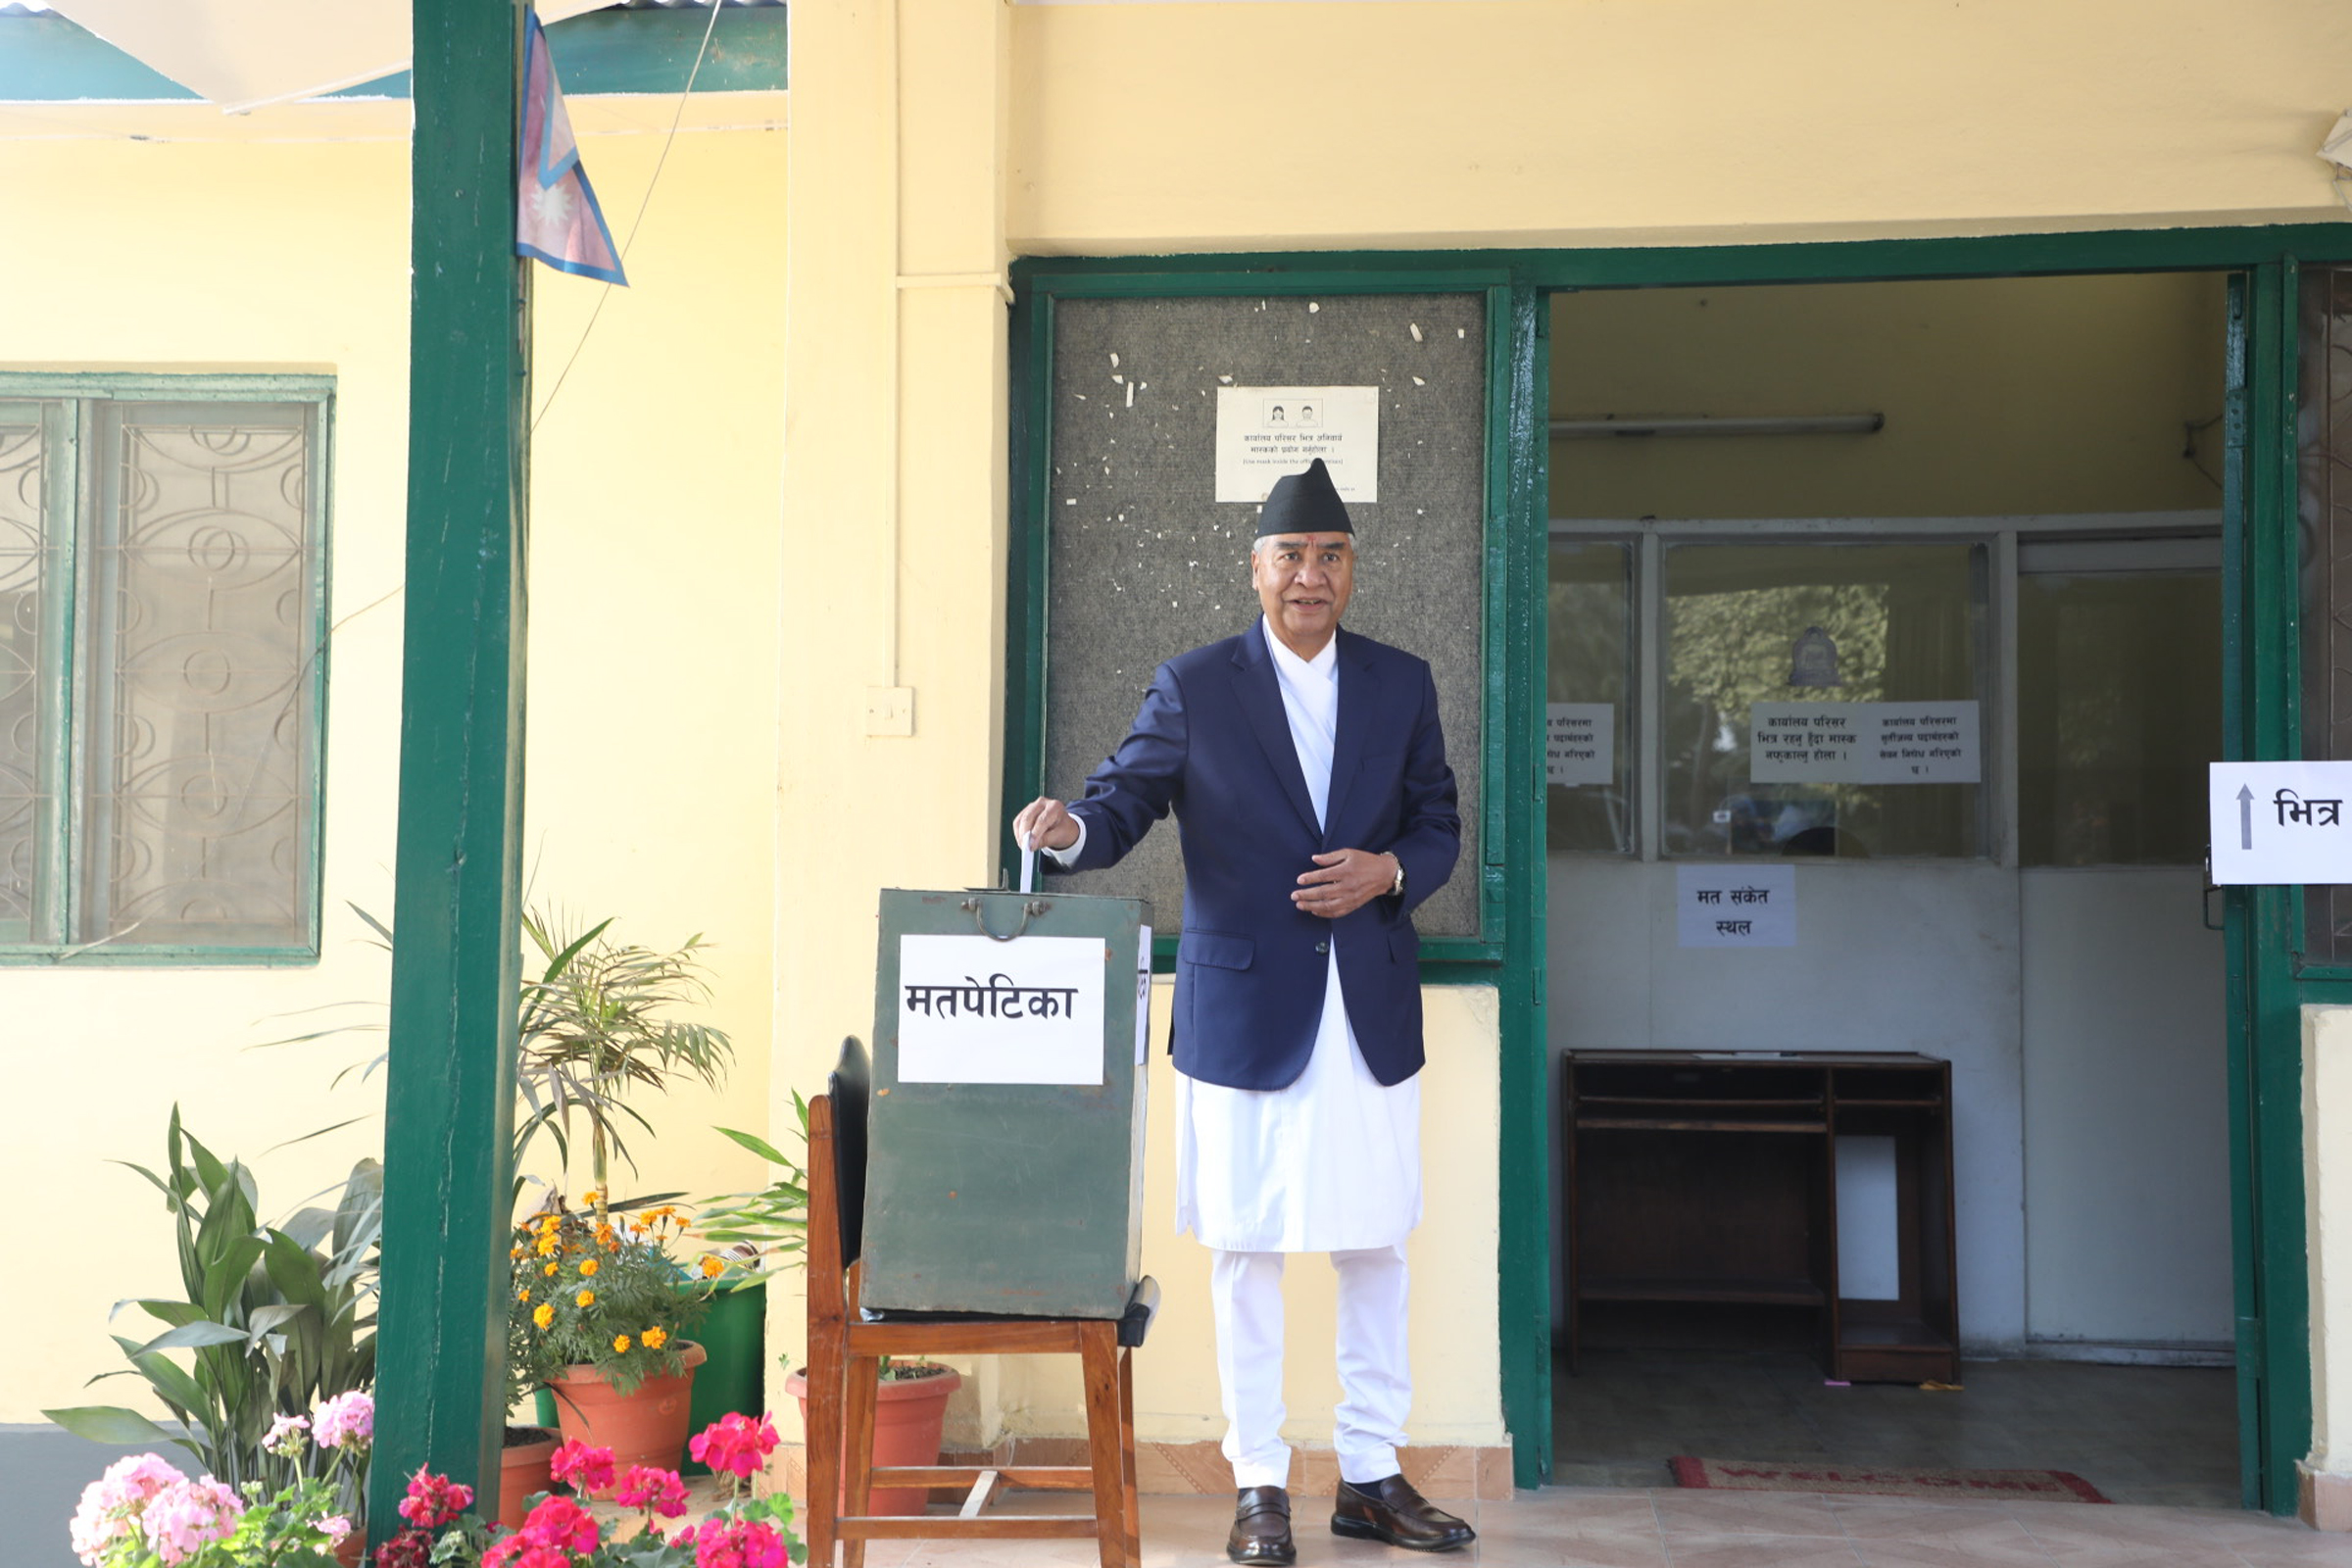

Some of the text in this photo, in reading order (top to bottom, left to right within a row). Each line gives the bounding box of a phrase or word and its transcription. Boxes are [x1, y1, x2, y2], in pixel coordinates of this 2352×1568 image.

[1767, 713, 1846, 728] कार्यालय परिसर
[1882, 715, 1957, 727] कार्यालय परिसरमा
[1757, 730, 1778, 743] भित्र
[1783, 734, 1803, 747] रहनु
[1829, 734, 1857, 744] मास्क
[1813, 748, 1836, 760] होला
[2273, 788, 2344, 827] भित्र
[1696, 885, 1770, 906] मत संकेत
[1715, 920, 1752, 937] स्थल
[905, 973, 1079, 1019] मतपेटिका
[1717, 1466, 2061, 1492] WELCOME
